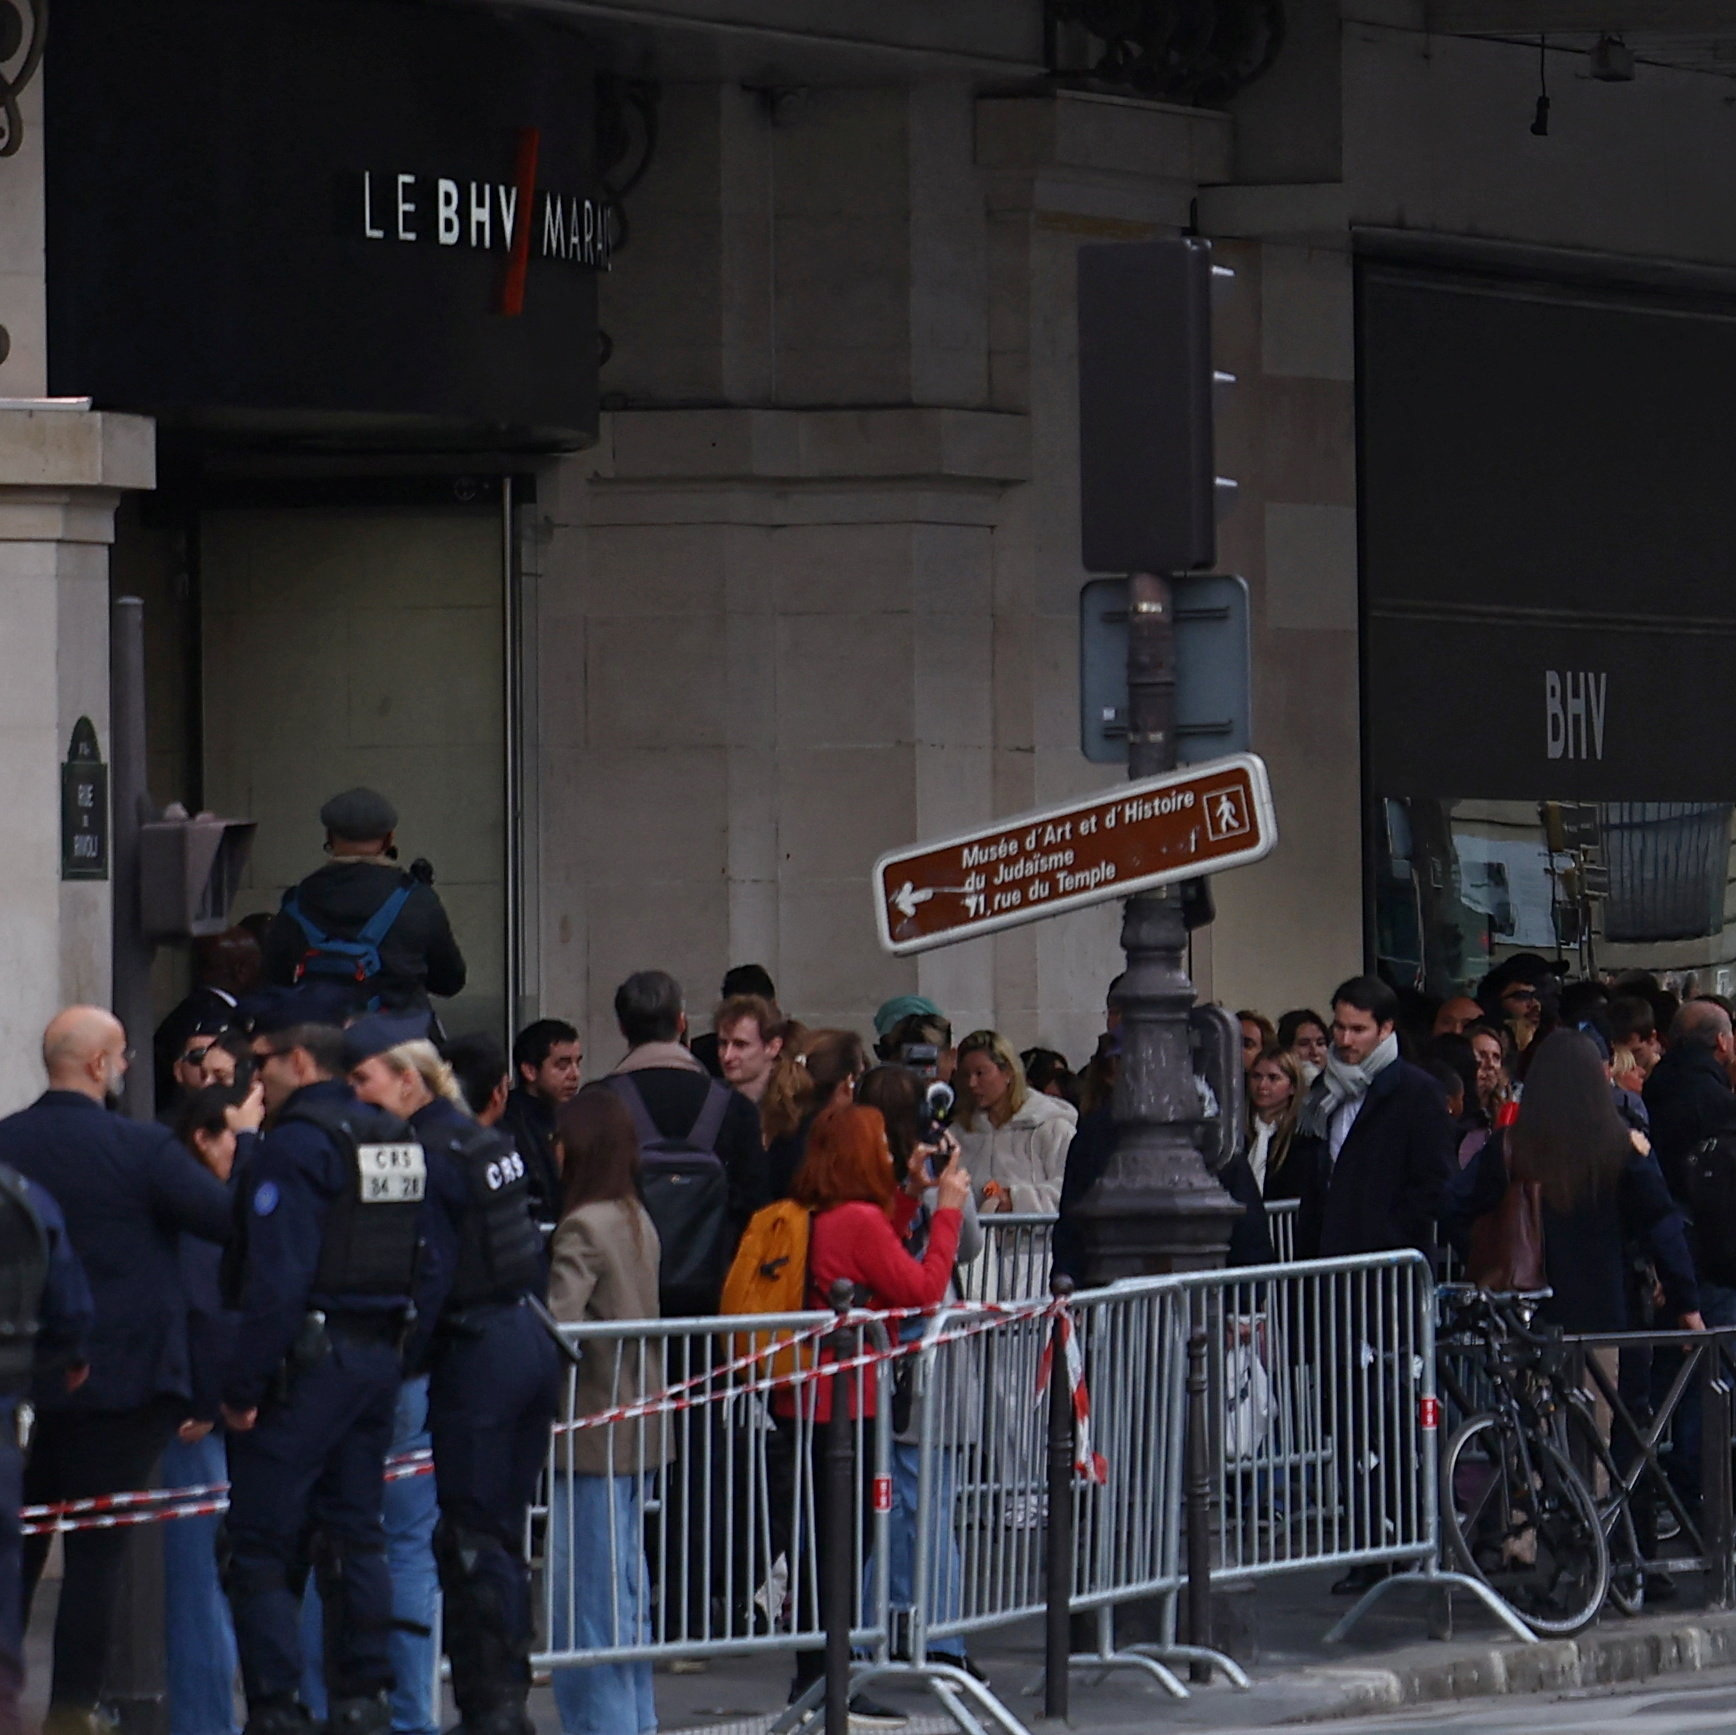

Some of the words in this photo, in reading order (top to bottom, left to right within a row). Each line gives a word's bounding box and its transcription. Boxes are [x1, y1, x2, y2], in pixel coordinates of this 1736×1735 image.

[364, 170, 417, 241] LE
[437, 178, 518, 253] BHV
[1545, 670, 1607, 761] BHV
[962, 839, 1018, 868] Musée
[1079, 815, 1097, 836] et
[964, 871, 986, 892] du
[993, 849, 1074, 884] Judaïsme
[994, 887, 1021, 911] rue
[1028, 880, 1049, 901] du
[1056, 860, 1116, 891] Temple
[376, 1150, 411, 1169] CRS
